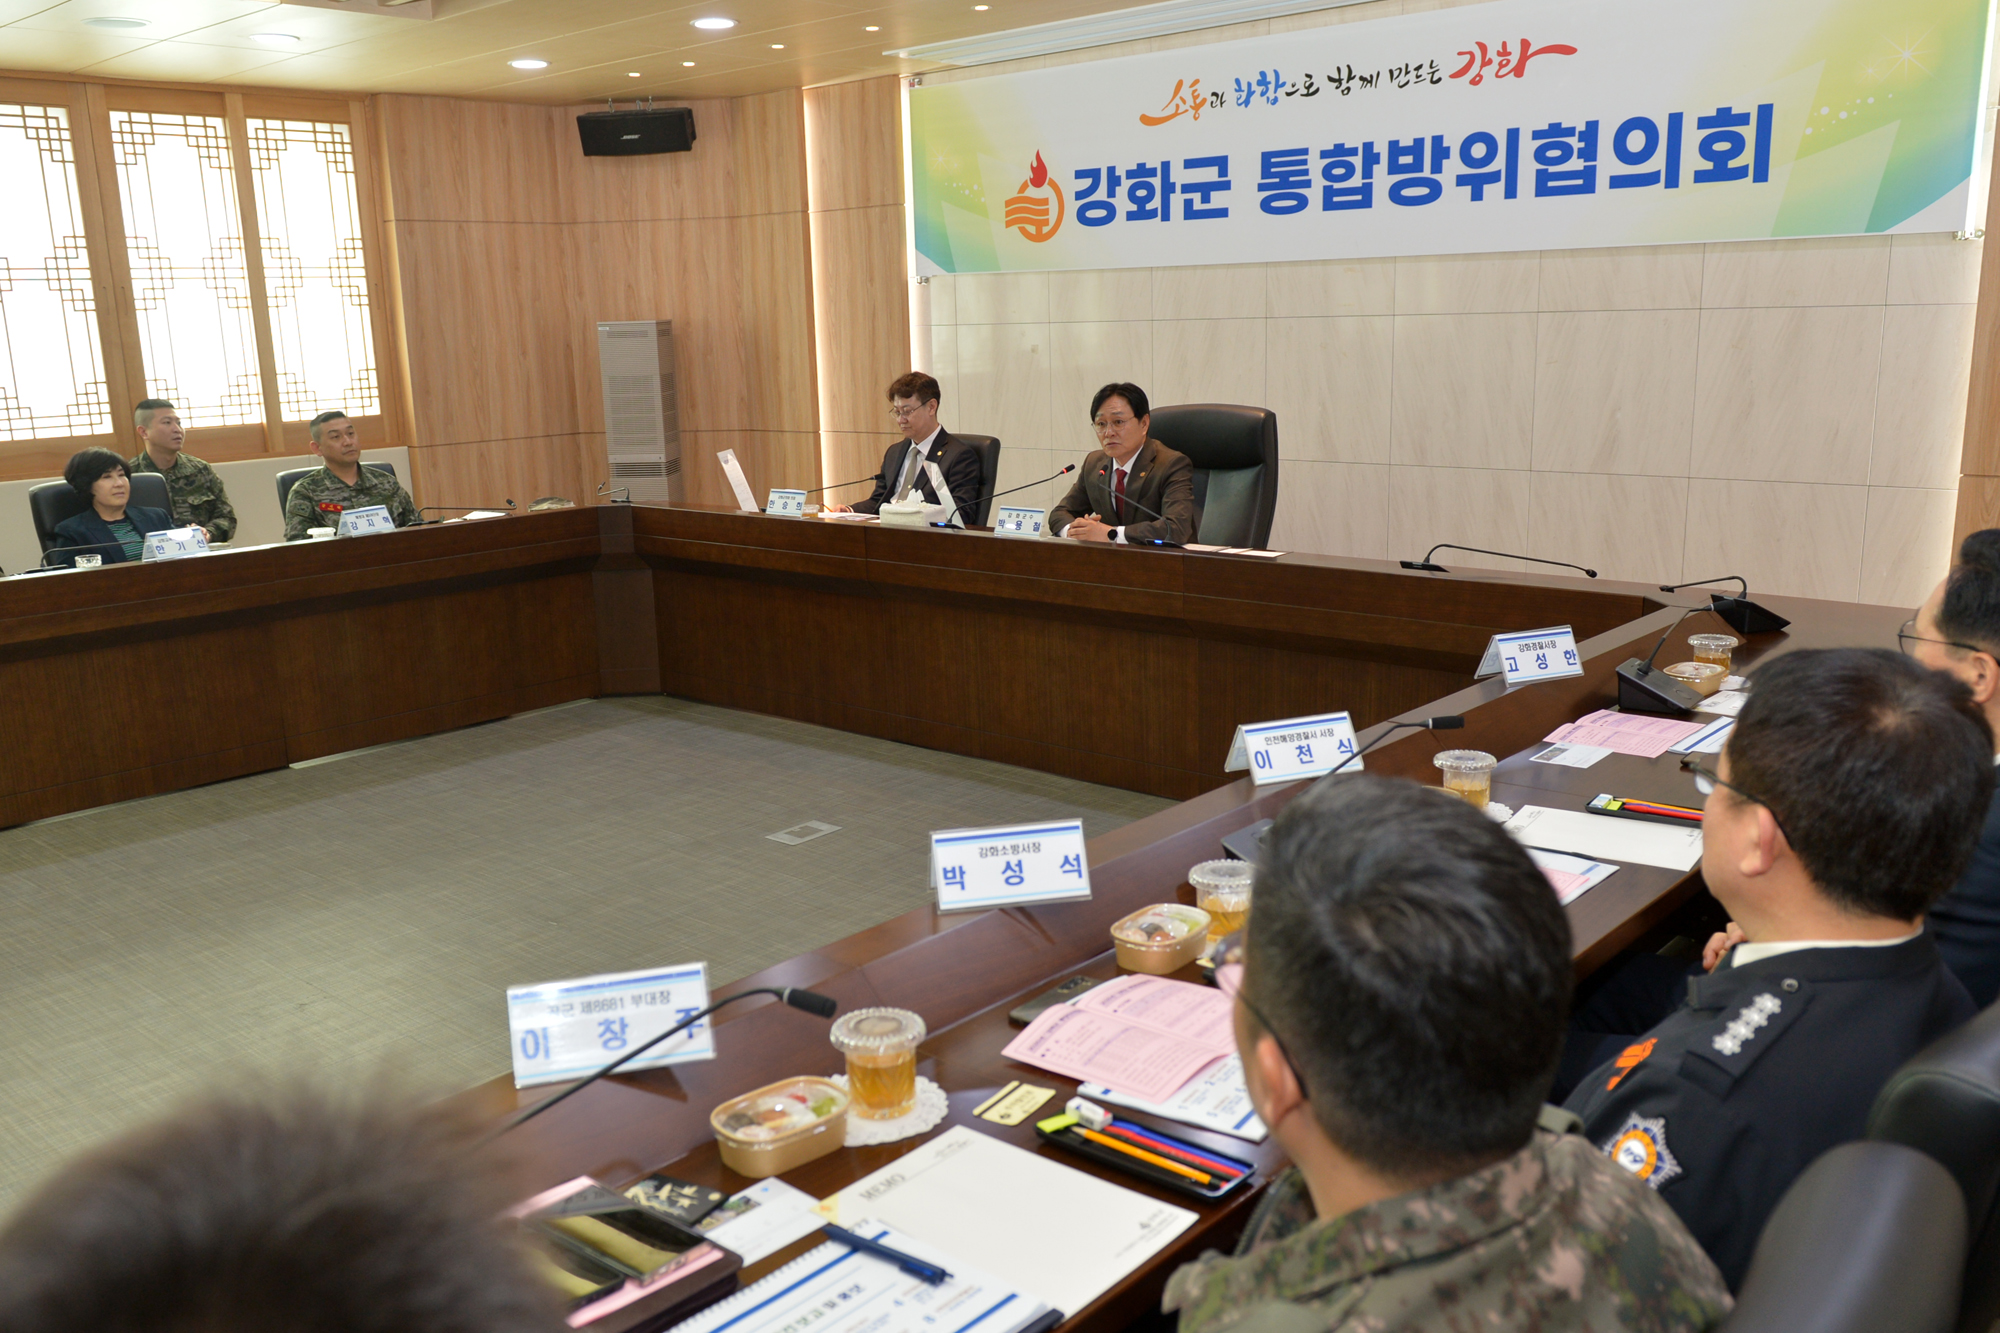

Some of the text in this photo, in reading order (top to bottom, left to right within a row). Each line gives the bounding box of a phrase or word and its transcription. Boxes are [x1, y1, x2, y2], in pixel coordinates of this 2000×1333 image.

[1139, 37, 1578, 126] 소통과 화합으로 함께 만드는 강화
[1074, 103, 1774, 227] 강화군 통합방위협의회
[1518, 639, 1557, 653] 강화경찰서장
[1264, 728, 1335, 746] 인천해양경찰서 서장
[978, 842, 1041, 858] 강화소방서장
[631, 990, 671, 1008] 부대장
[859, 1172, 907, 1202] MEMO
